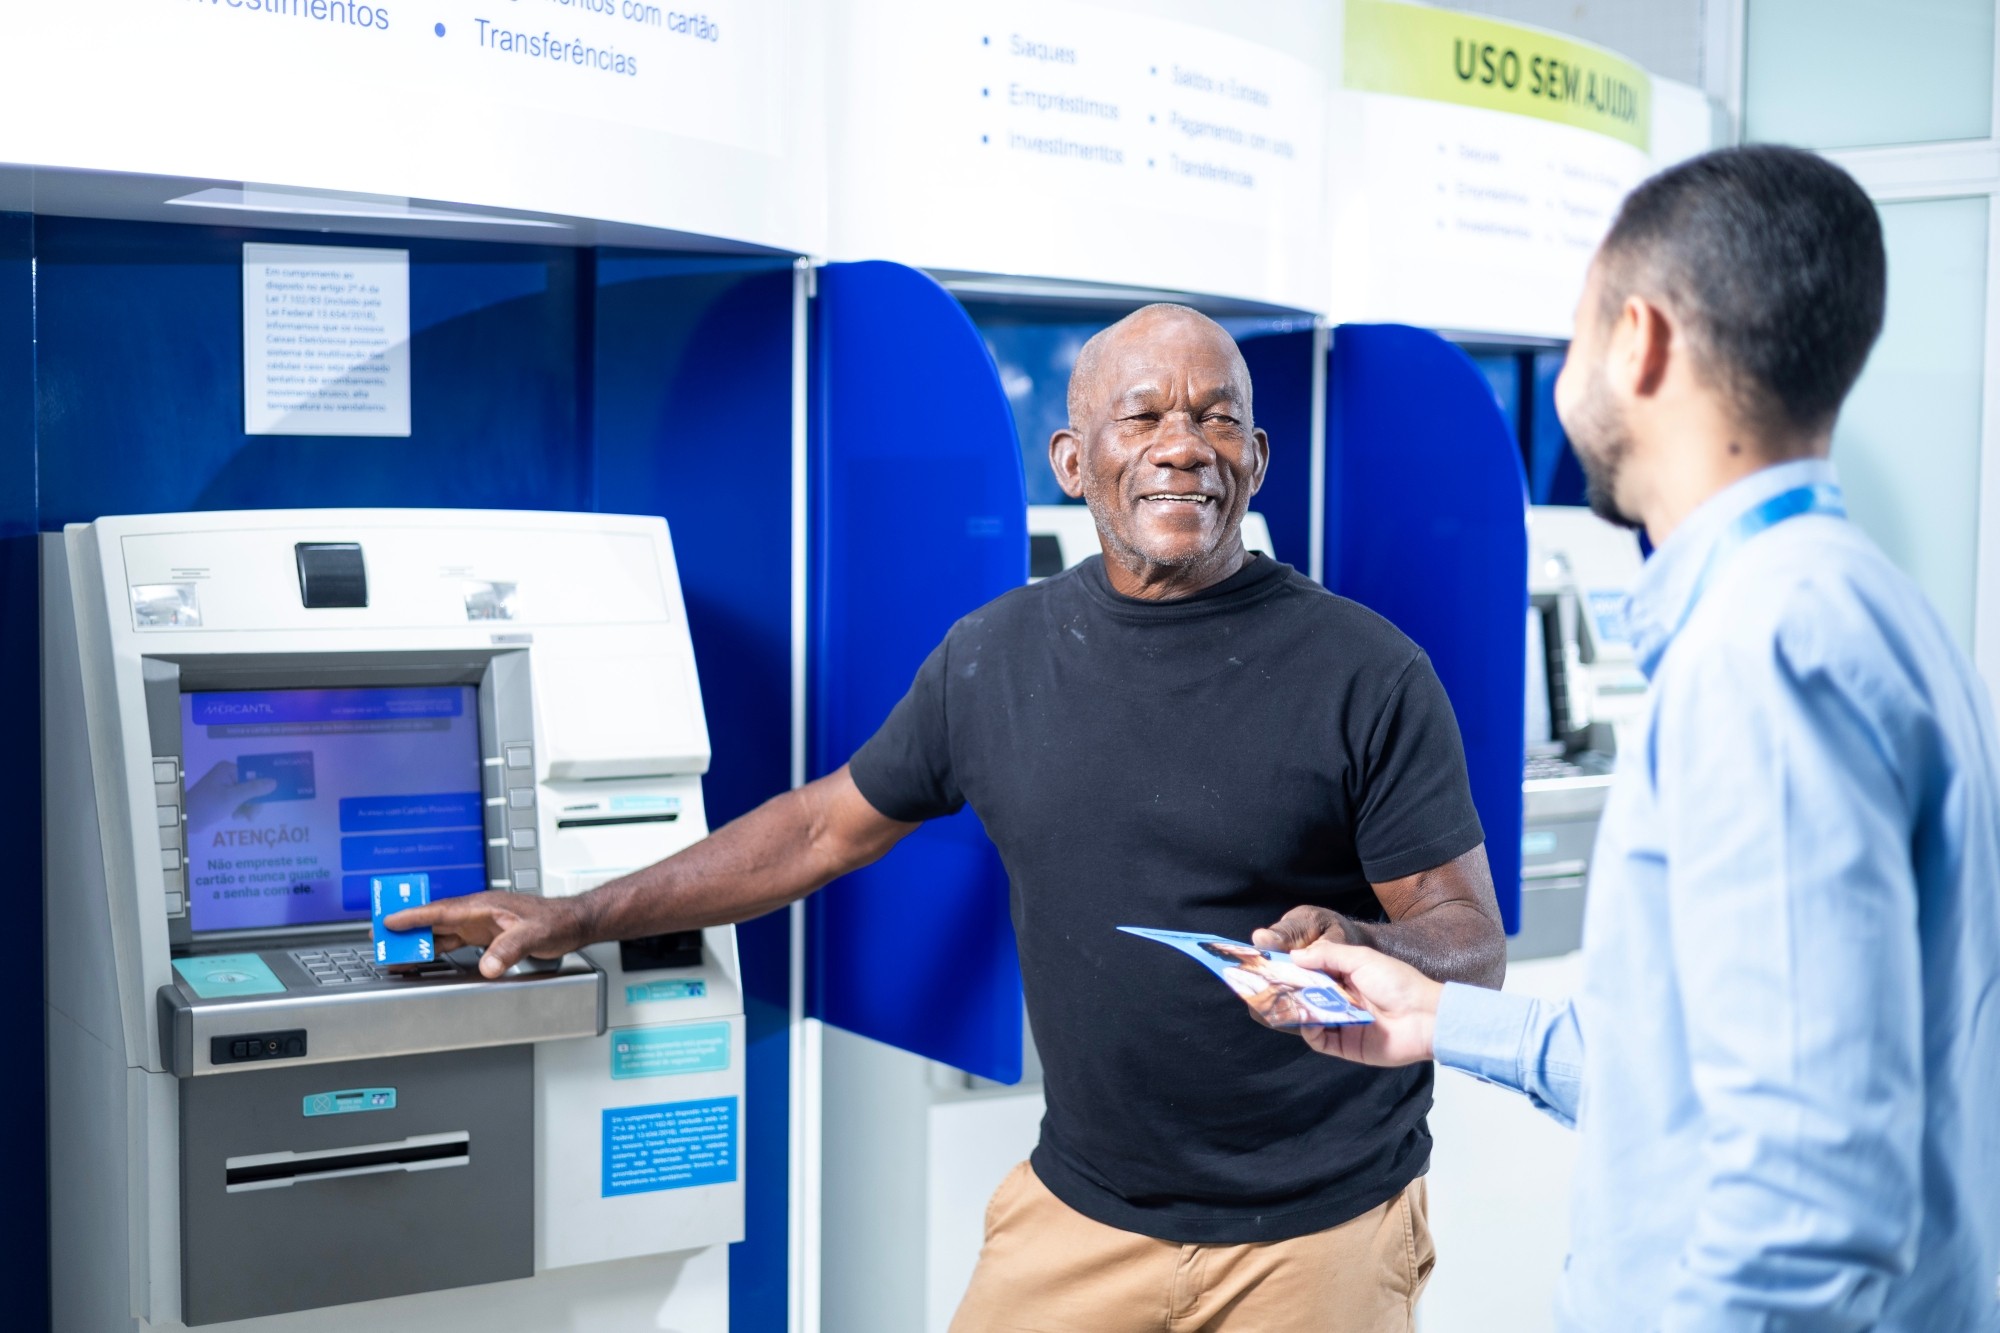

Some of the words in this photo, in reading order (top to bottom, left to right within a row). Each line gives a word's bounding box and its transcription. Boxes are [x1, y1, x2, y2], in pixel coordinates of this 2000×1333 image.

[622, 0, 662, 27] com
[667, 10, 719, 43] cartão
[474, 17, 638, 77] Transferências
[1009, 34, 1077, 65] Saques
[1454, 38, 1521, 90] USO
[1008, 130, 1124, 166] Investimentos
[212, 826, 310, 849] ATENÇÃO!
[195, 872, 236, 886] cartão
[239, 874, 247, 883] e
[249, 872, 286, 883] nunca
[289, 867, 331, 883] guarde
[207, 858, 233, 871] Não
[235, 857, 294, 874] empreste
[296, 855, 318, 867] seu
[213, 890, 221, 900] a
[224, 886, 260, 899] senha
[263, 885, 290, 896] com
[293, 883, 315, 895] ele.
[377, 940, 387, 962] VISA
